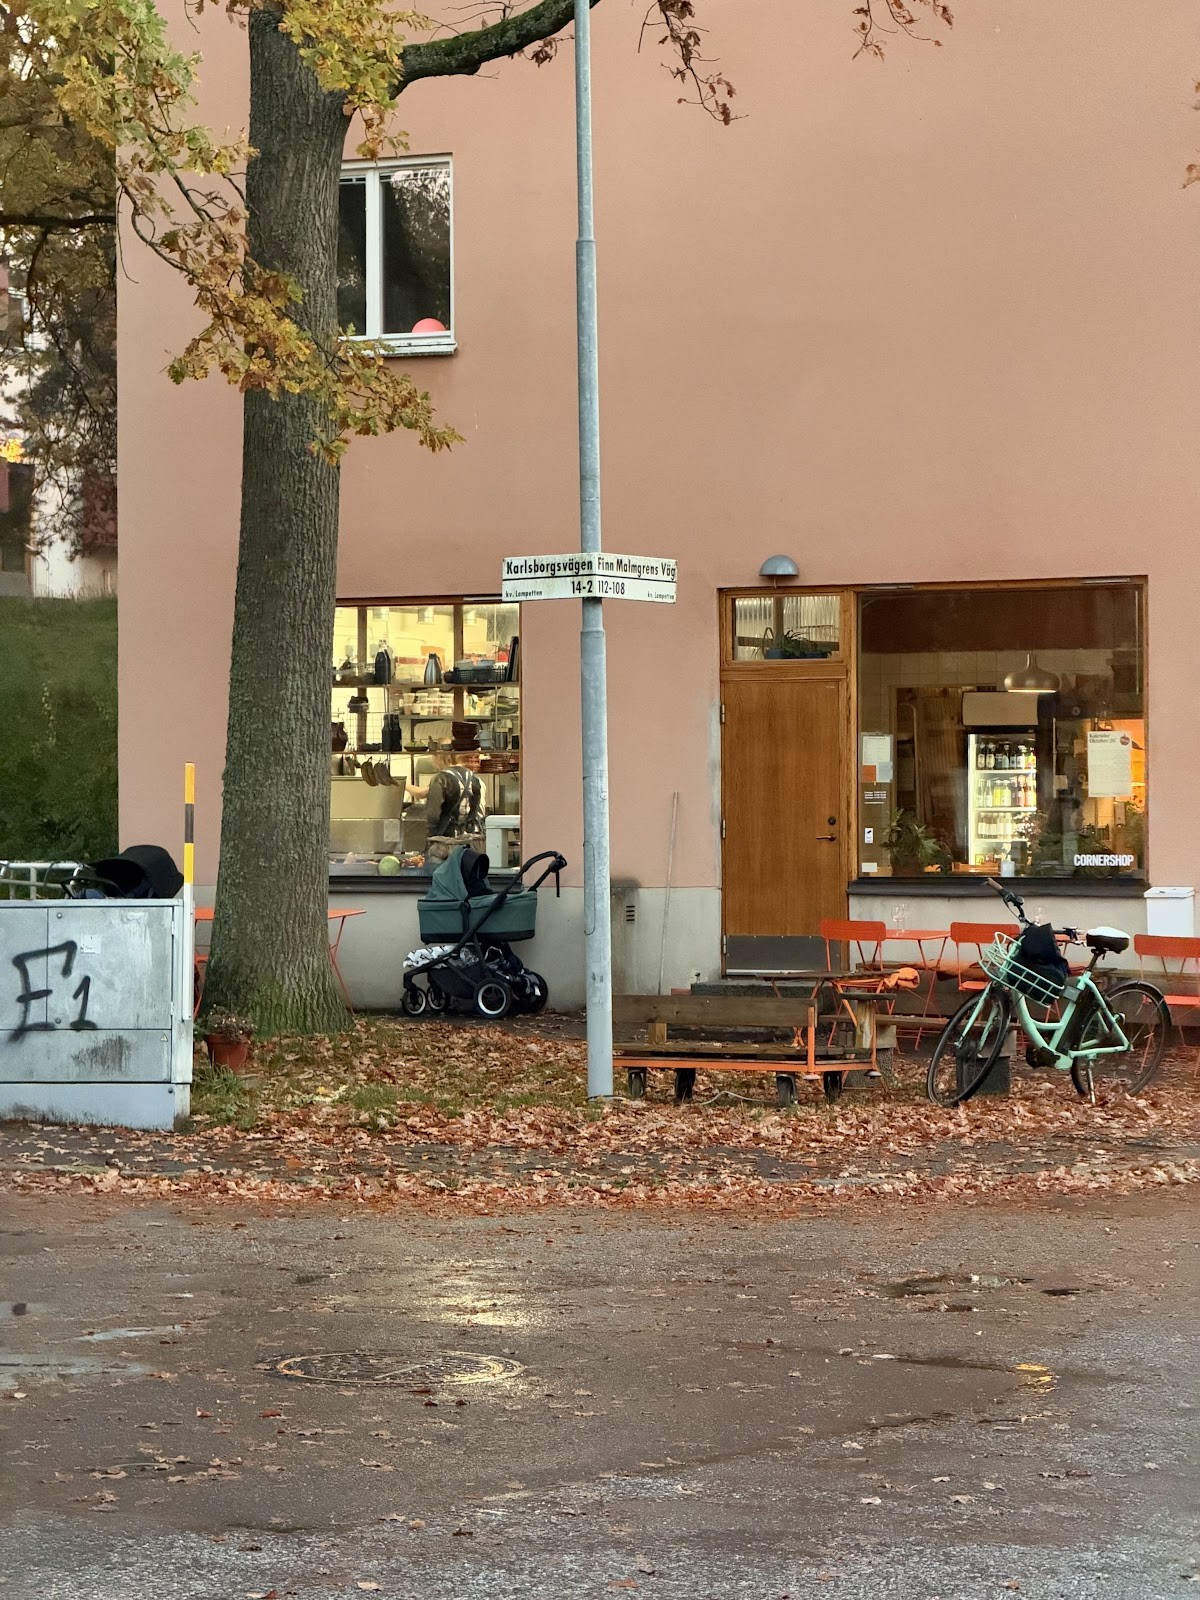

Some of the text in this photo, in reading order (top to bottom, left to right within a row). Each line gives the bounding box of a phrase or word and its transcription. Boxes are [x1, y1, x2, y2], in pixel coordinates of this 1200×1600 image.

[506, 558, 593, 576] Karlsborgsvägen
[597, 557, 676, 581] Finn Malmgrens Väg
[571, 580, 593, 594] 14-2
[598, 580, 625, 595] 112-108
[505, 590, 543, 599] kv. Lampetten
[1073, 854, 1134, 867] CORNERSHOP
